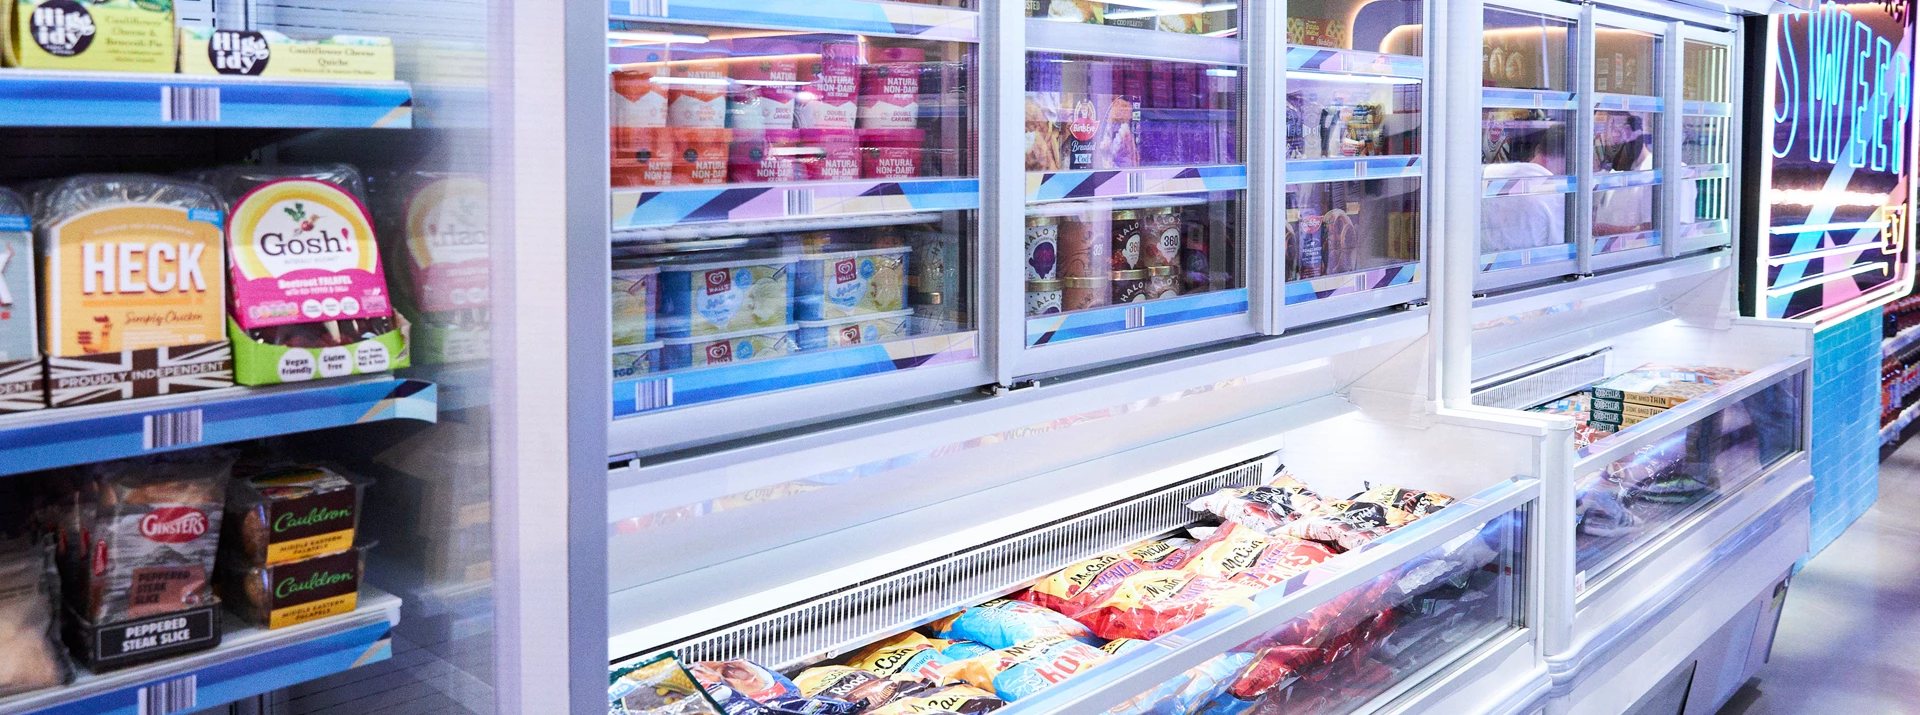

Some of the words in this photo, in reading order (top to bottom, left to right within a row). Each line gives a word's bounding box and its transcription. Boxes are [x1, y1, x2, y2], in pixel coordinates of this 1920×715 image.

[887, 77, 918, 87] NATURAL
[883, 85, 919, 94] NON-DAIRY
[825, 159, 858, 169] NATURAL
[879, 158, 913, 168] NATURAL
[876, 166, 915, 175] NON-DAIRY
[1116, 221, 1139, 242] HALO
[260, 226, 353, 256] Gosh!
[1164, 235, 1180, 247] 360
[82, 241, 207, 295] HECK
[285, 358, 309, 368] Vegan
[323, 354, 346, 362] Gluten
[58, 372, 128, 389] PROUDLY
[131, 360, 225, 381] INDEPENDENT
[281, 366, 313, 376] Friendly
[1650, 396, 1666, 405] THIN
[273, 507, 353, 533] Cauldron
[275, 571, 354, 599] Cauldron
[281, 607, 310, 618] MIDDLE
[313, 599, 345, 612] EASTERN
[125, 617, 188, 638] PEPPERED
[122, 636, 158, 652] STEAK
[160, 629, 191, 645] SLICE
